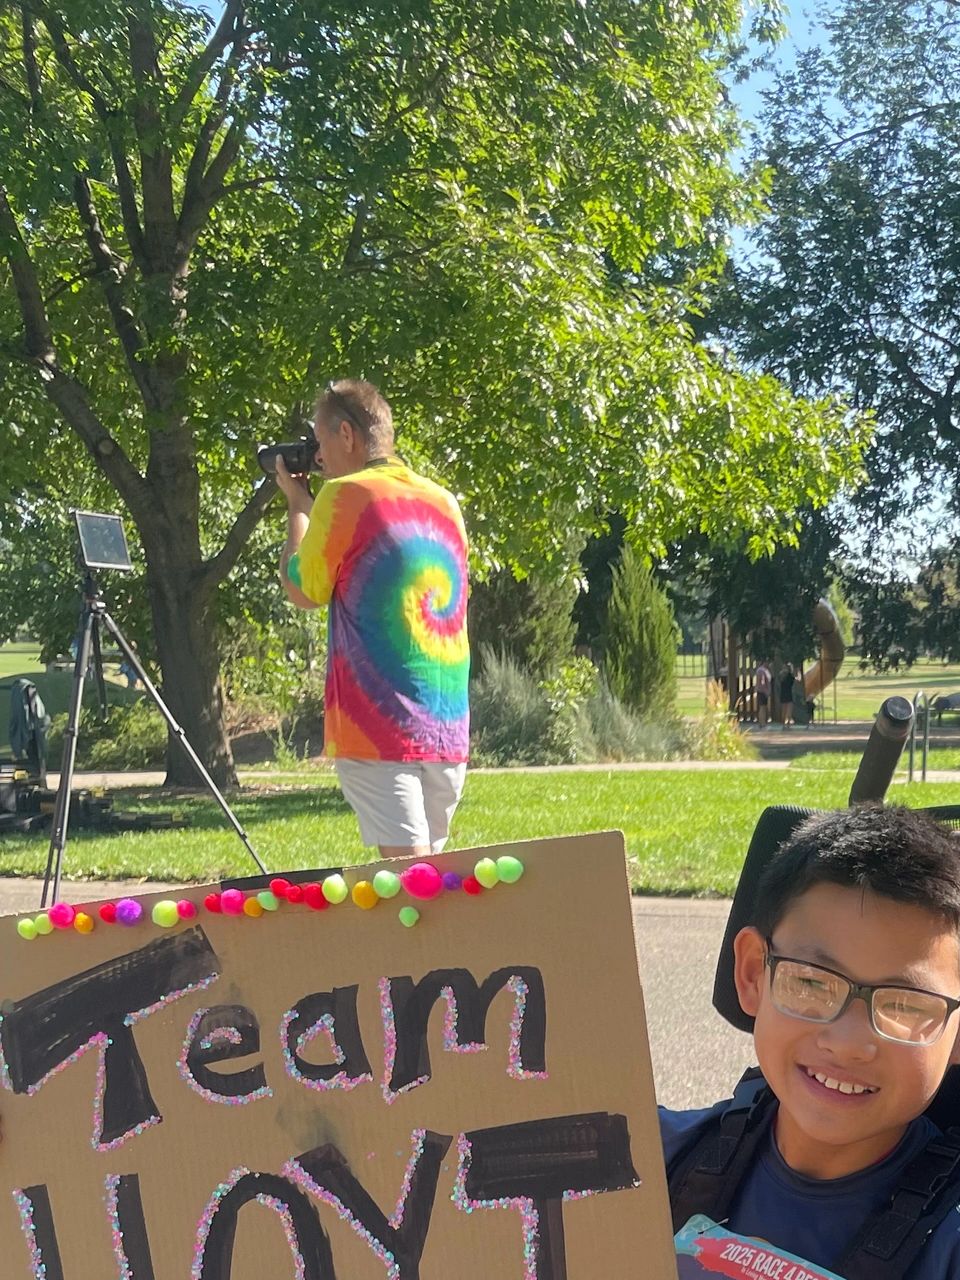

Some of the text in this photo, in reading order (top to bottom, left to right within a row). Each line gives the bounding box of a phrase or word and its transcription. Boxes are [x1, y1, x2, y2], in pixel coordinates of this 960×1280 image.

[0, 924, 548, 1152] Team
[719, 1243, 757, 1267] 2025
[751, 1252, 789, 1280] RACE
